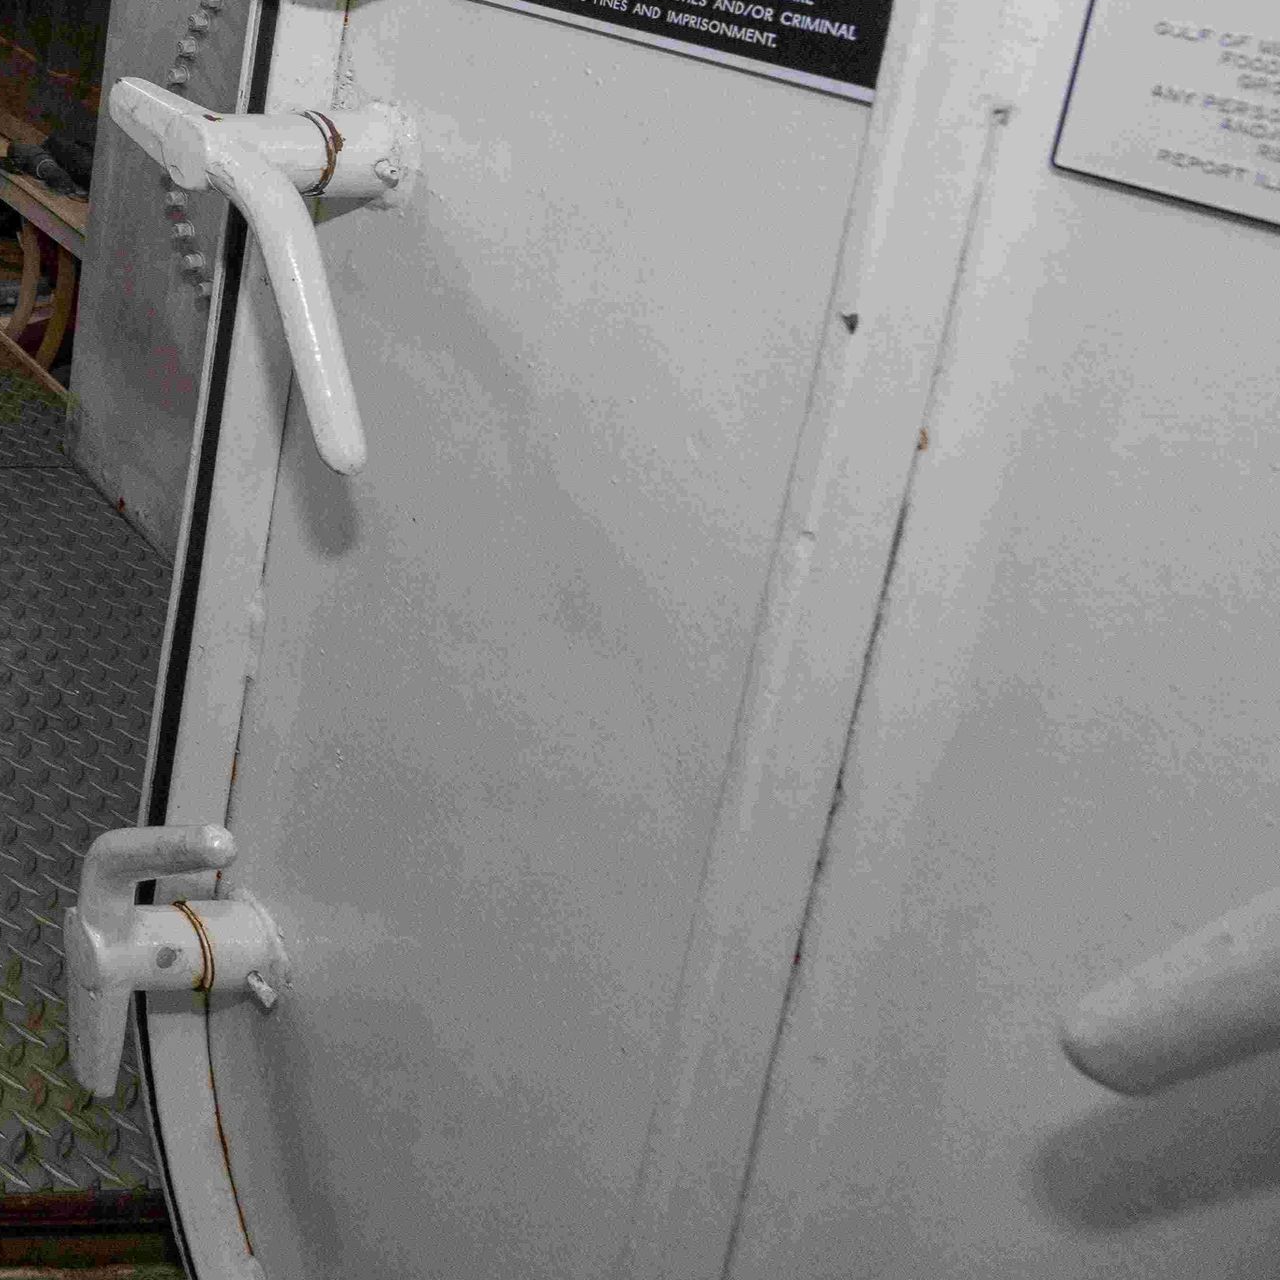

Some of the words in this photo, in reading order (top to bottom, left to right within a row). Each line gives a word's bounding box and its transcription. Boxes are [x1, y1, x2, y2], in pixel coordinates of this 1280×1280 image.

[632, 2, 661, 19] AND
[666, 9, 777, 48] IMPRISONMENT.
[779, 11, 856, 41] CRIMINAL
